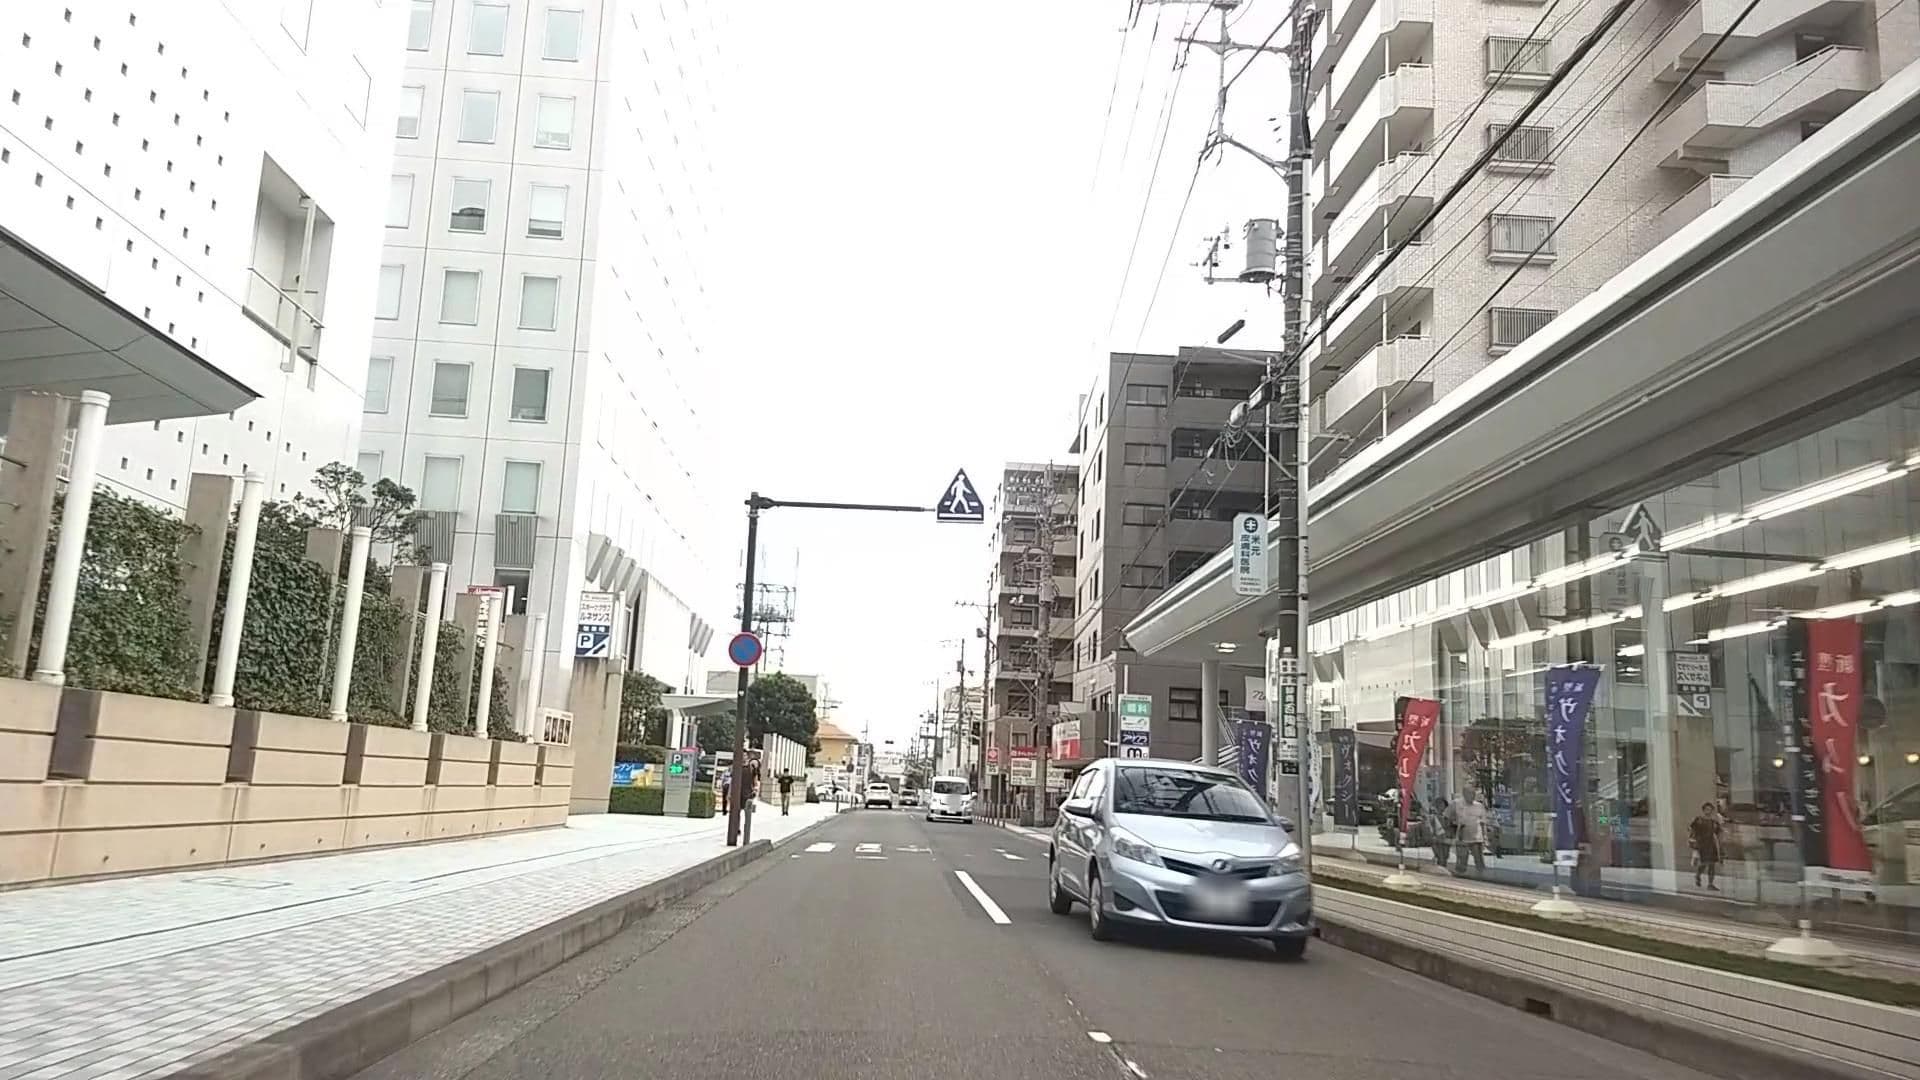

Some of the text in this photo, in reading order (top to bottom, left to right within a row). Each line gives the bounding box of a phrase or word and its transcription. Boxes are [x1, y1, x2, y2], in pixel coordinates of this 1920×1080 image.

[580, 612, 610, 622] ルネサンス
[580, 635, 591, 646] P
